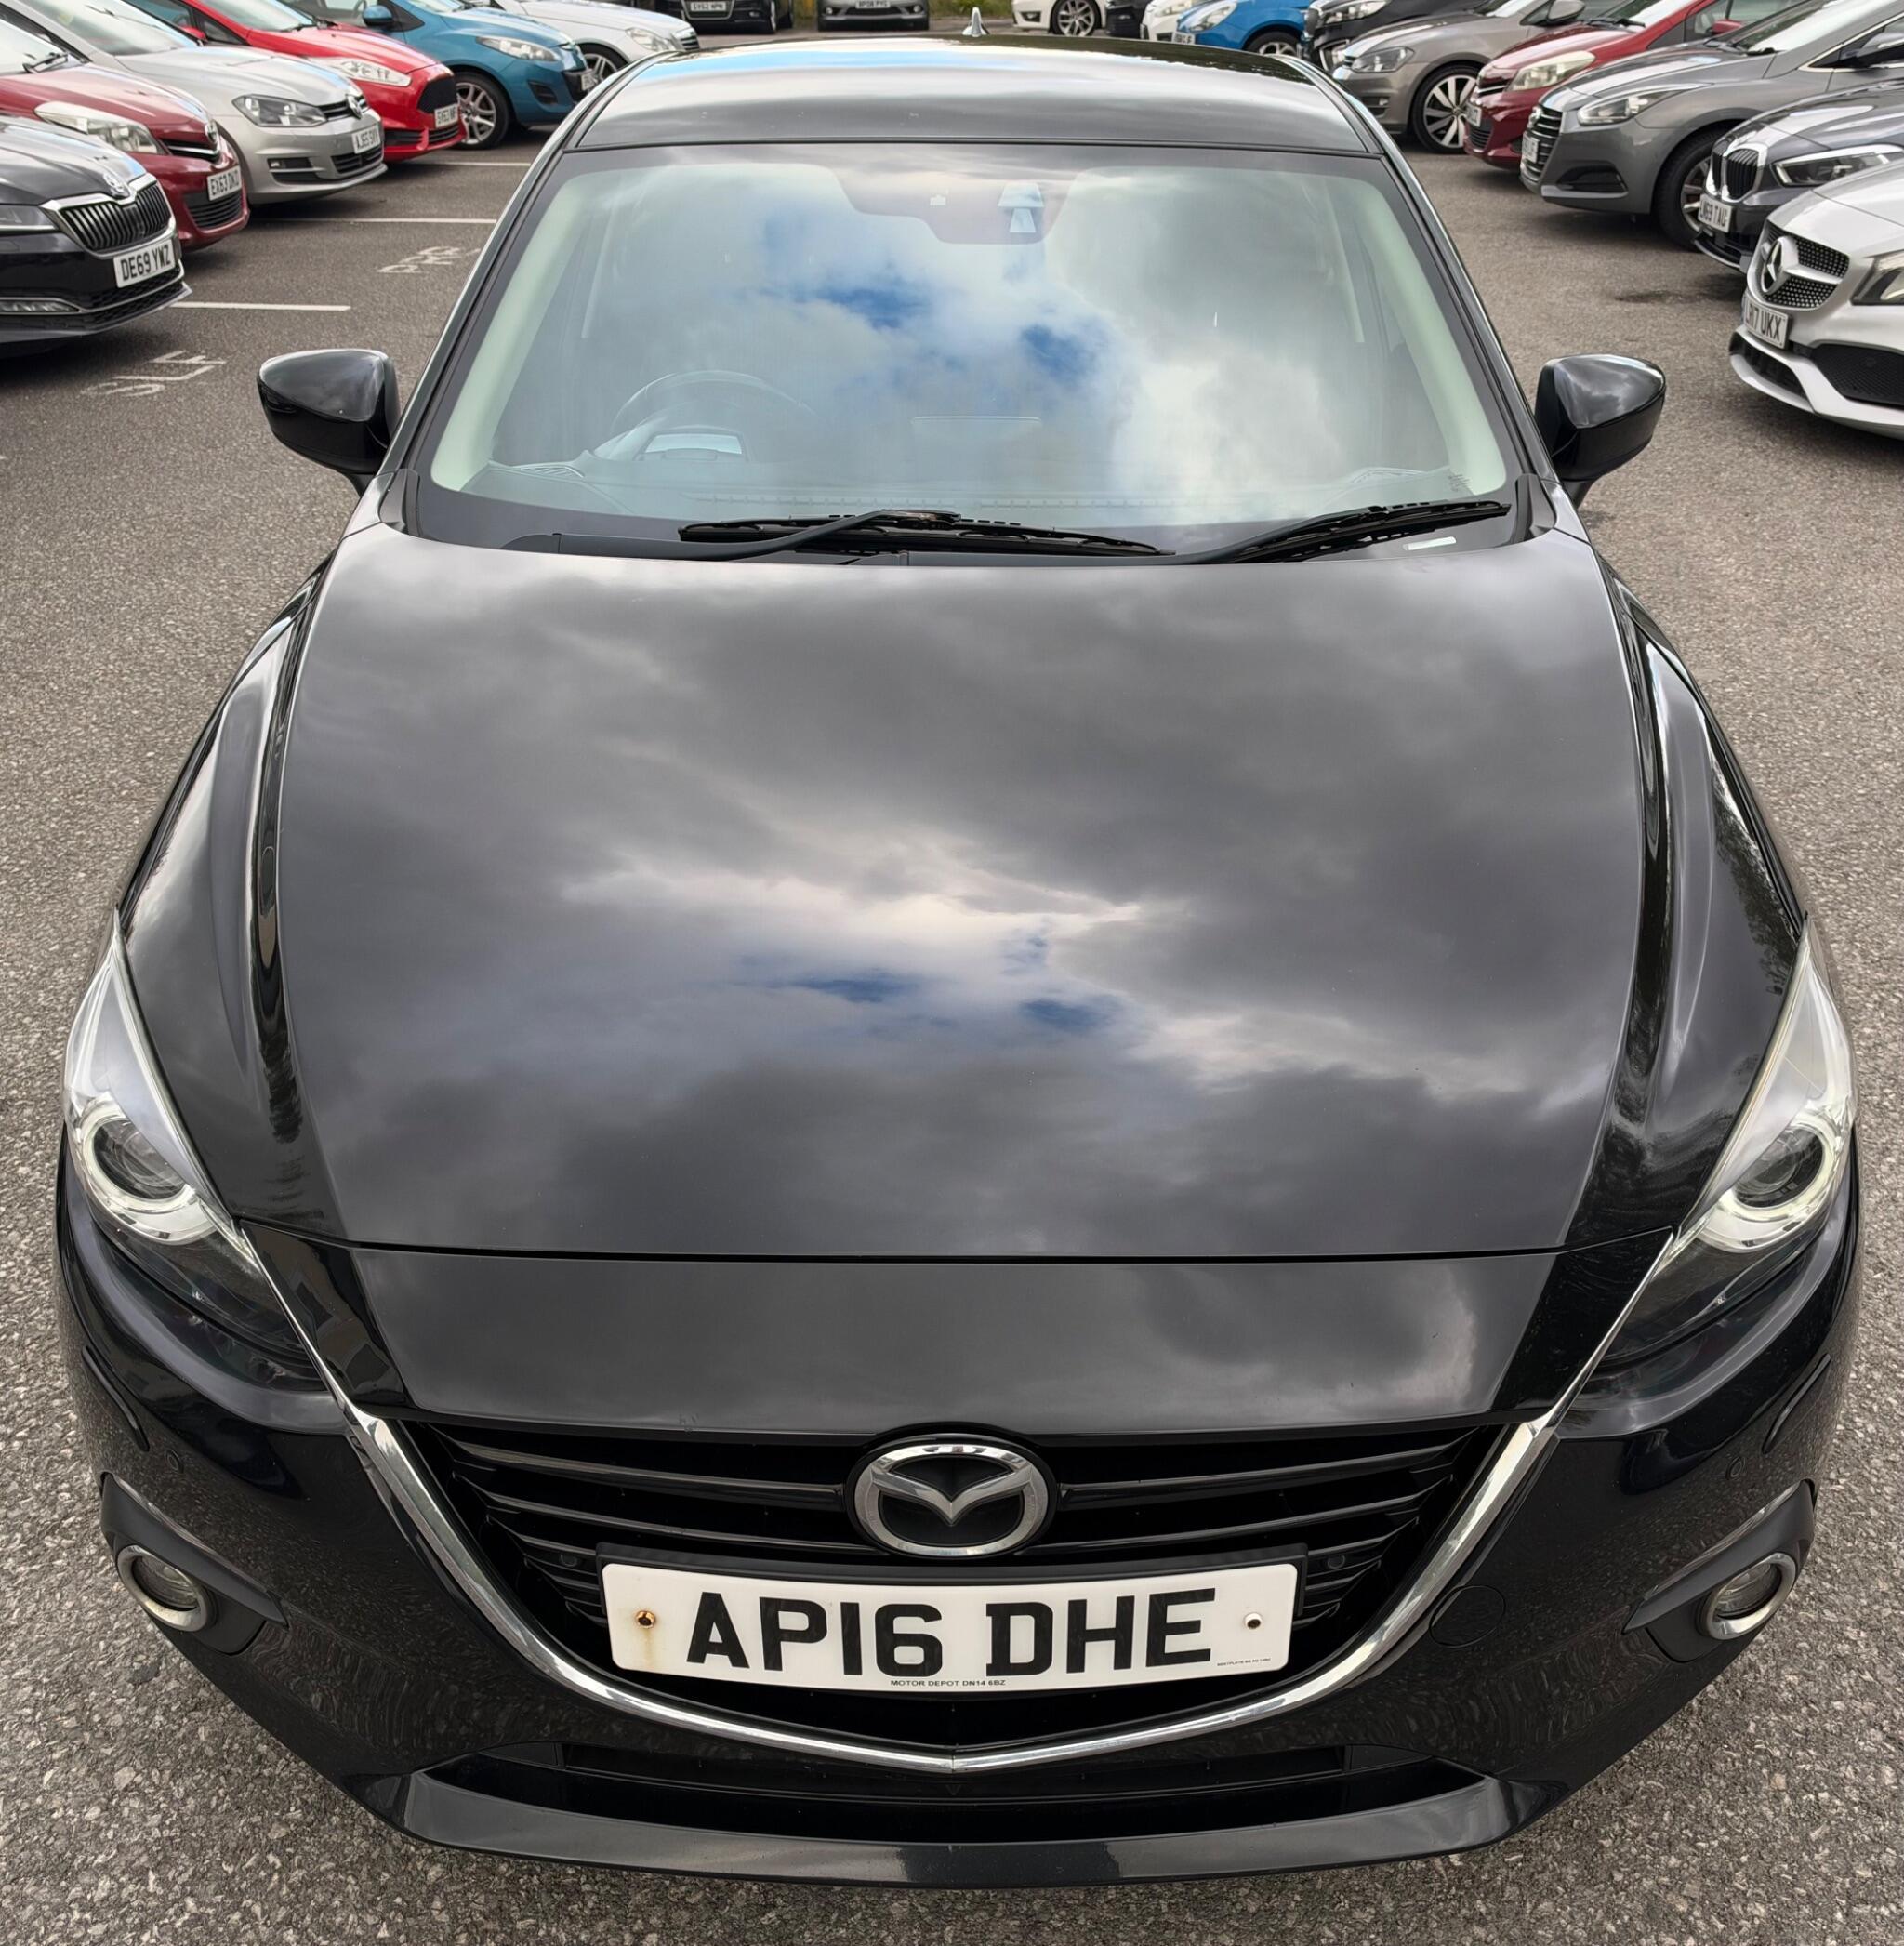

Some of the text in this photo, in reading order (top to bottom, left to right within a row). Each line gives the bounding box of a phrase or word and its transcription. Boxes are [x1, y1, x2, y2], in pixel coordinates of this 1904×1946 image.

[121, 245, 171, 281] DE69 YWZ
[1760, 310, 1782, 341] UKX
[686, 1588, 1216, 1676] AP16 DHE
